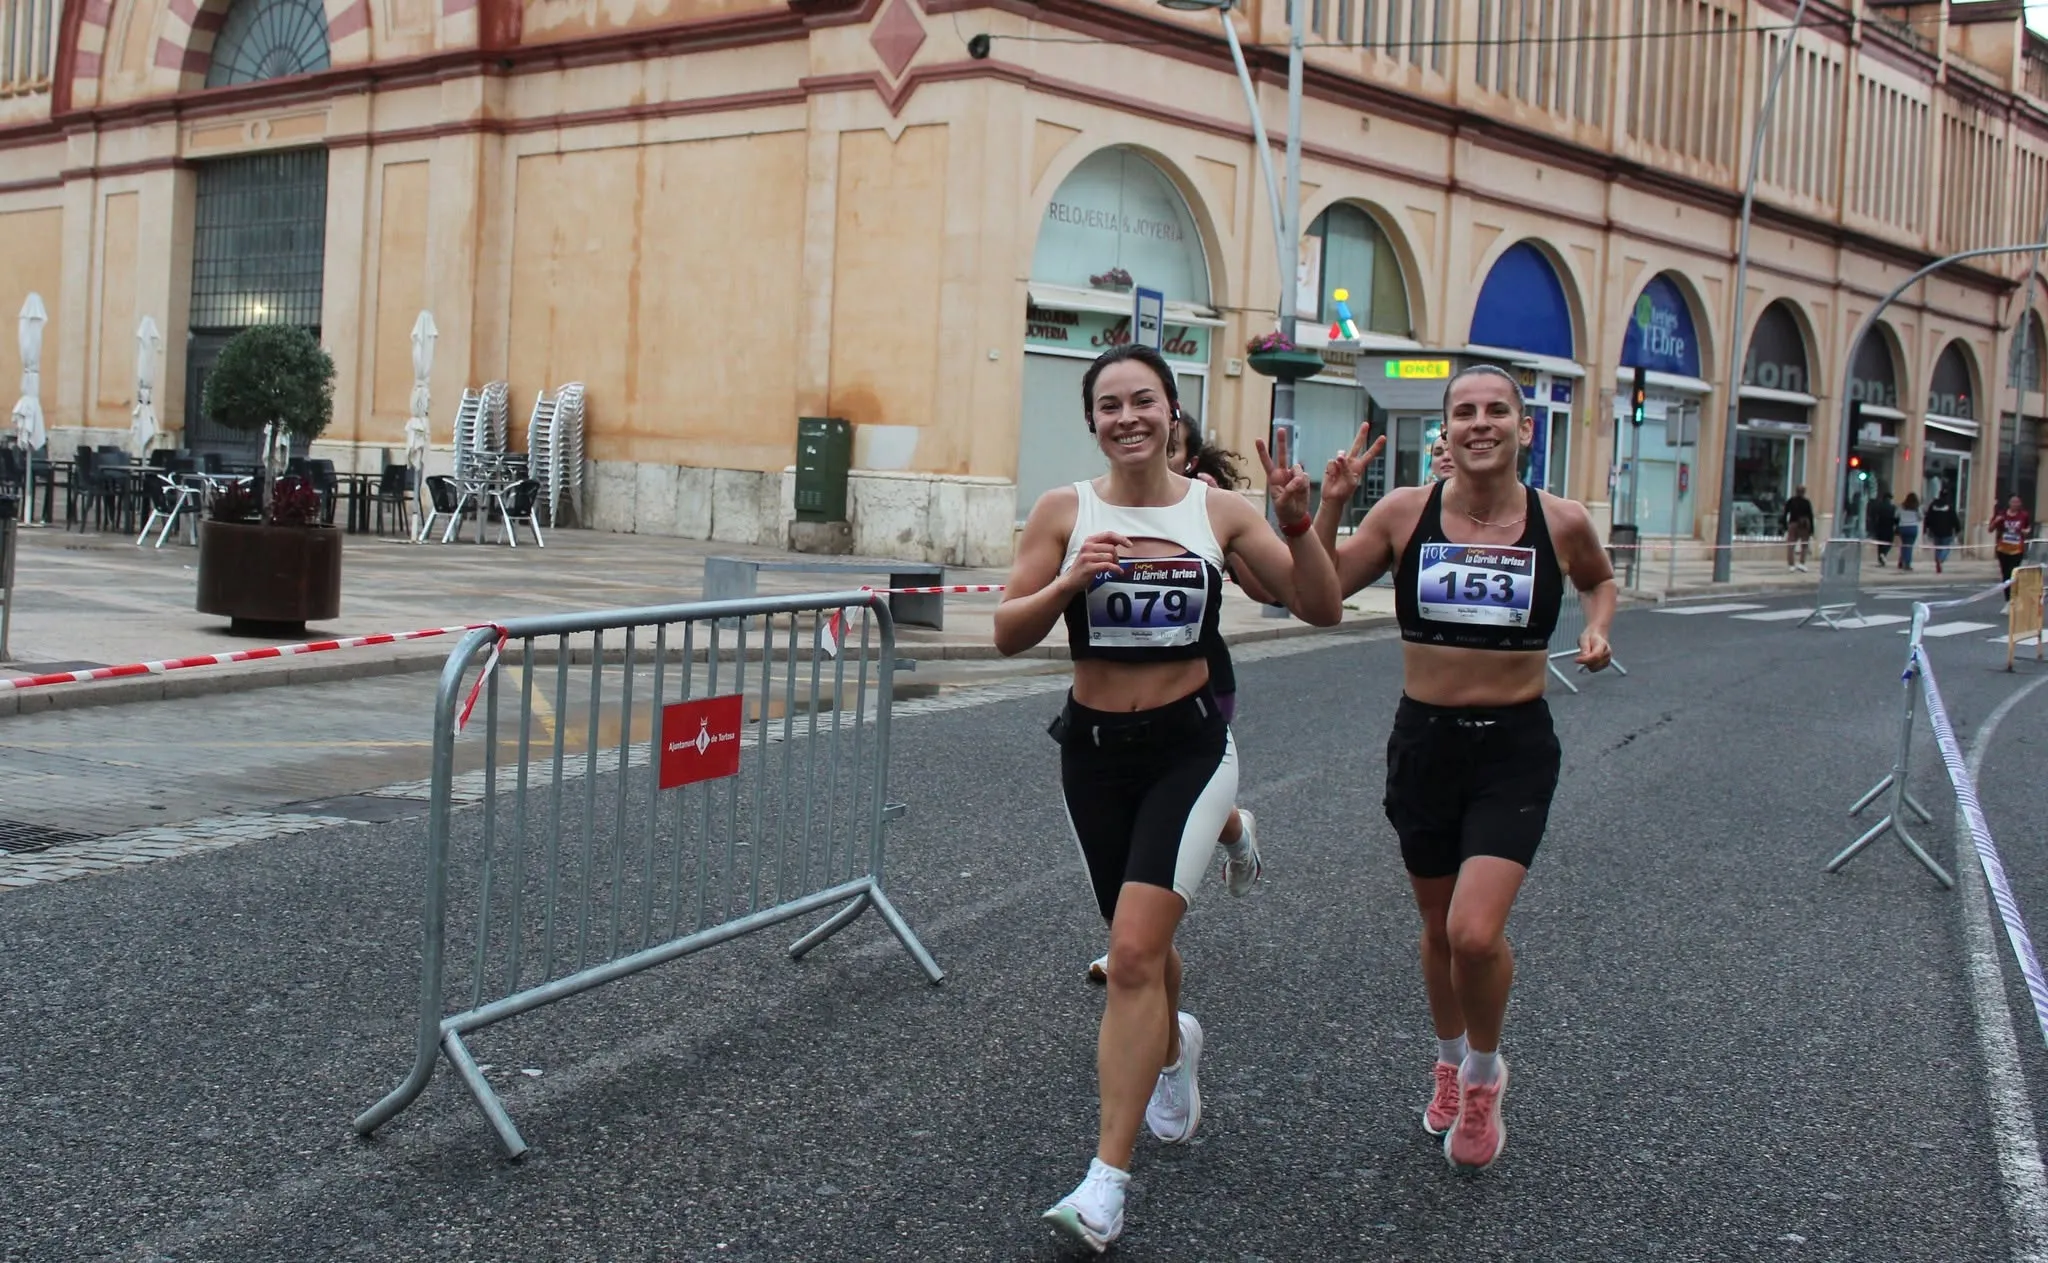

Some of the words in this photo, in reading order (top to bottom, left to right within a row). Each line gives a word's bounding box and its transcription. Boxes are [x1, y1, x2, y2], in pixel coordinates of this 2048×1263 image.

[1122, 216, 1131, 234] &
[1404, 364, 1444, 376] ONCE
[1501, 557, 1526, 567] Tortosa
[1171, 568, 1197, 579] Tortosa
[1438, 571, 1514, 604] 153
[1106, 590, 1188, 623] 079
[710, 734, 718, 743] de
[718, 732, 735, 742] Tortosa
